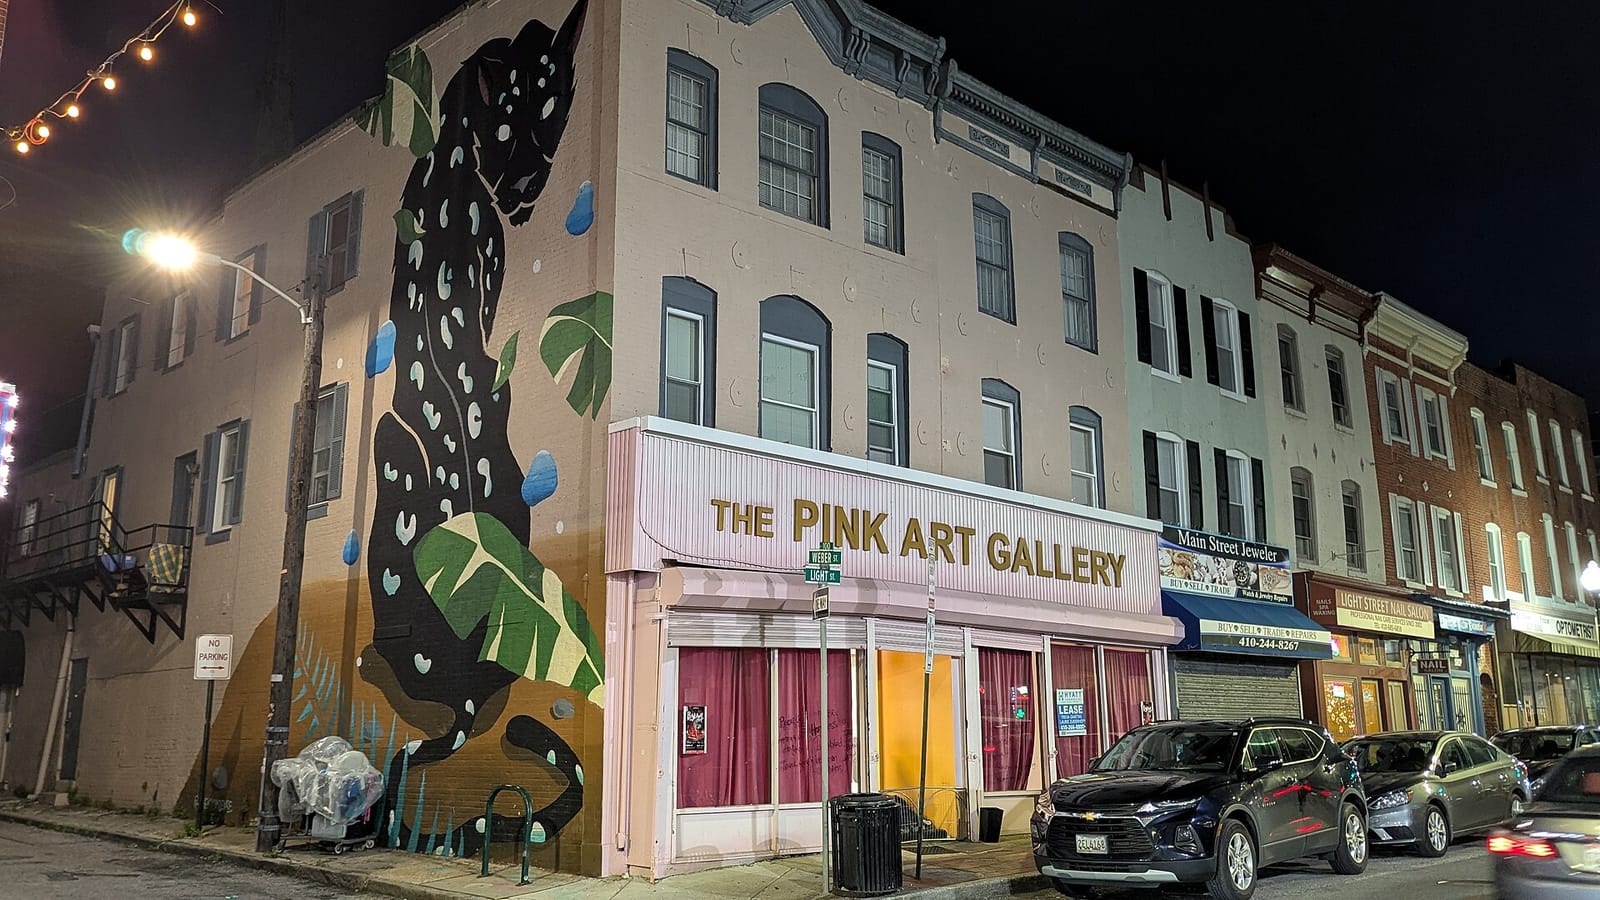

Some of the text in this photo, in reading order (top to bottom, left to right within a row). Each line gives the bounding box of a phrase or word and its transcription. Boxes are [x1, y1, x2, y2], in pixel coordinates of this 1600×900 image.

[711, 499, 774, 538] THE
[794, 498, 889, 554] PINK
[900, 518, 976, 565] ART
[987, 532, 1126, 588] GALLERY
[1177, 529, 1278, 562] Main Street Jeweler
[811, 552, 832, 563] WEBER
[810, 569, 828, 582] LIGHT
[1169, 578, 1232, 595] BUY SELL TRADE
[1340, 592, 1429, 620] LIGHT STREET NAIL SALON
[1217, 622, 1318, 640] BUY SELL TRADE REPAIRS
[1556, 620, 1594, 639] OPTOMETRIST
[1238, 637, 1299, 650] 410-244-8267
[199, 652, 228, 661] PARKING
[1420, 660, 1447, 669] NAIL
[1058, 705, 1084, 715] LEASE
